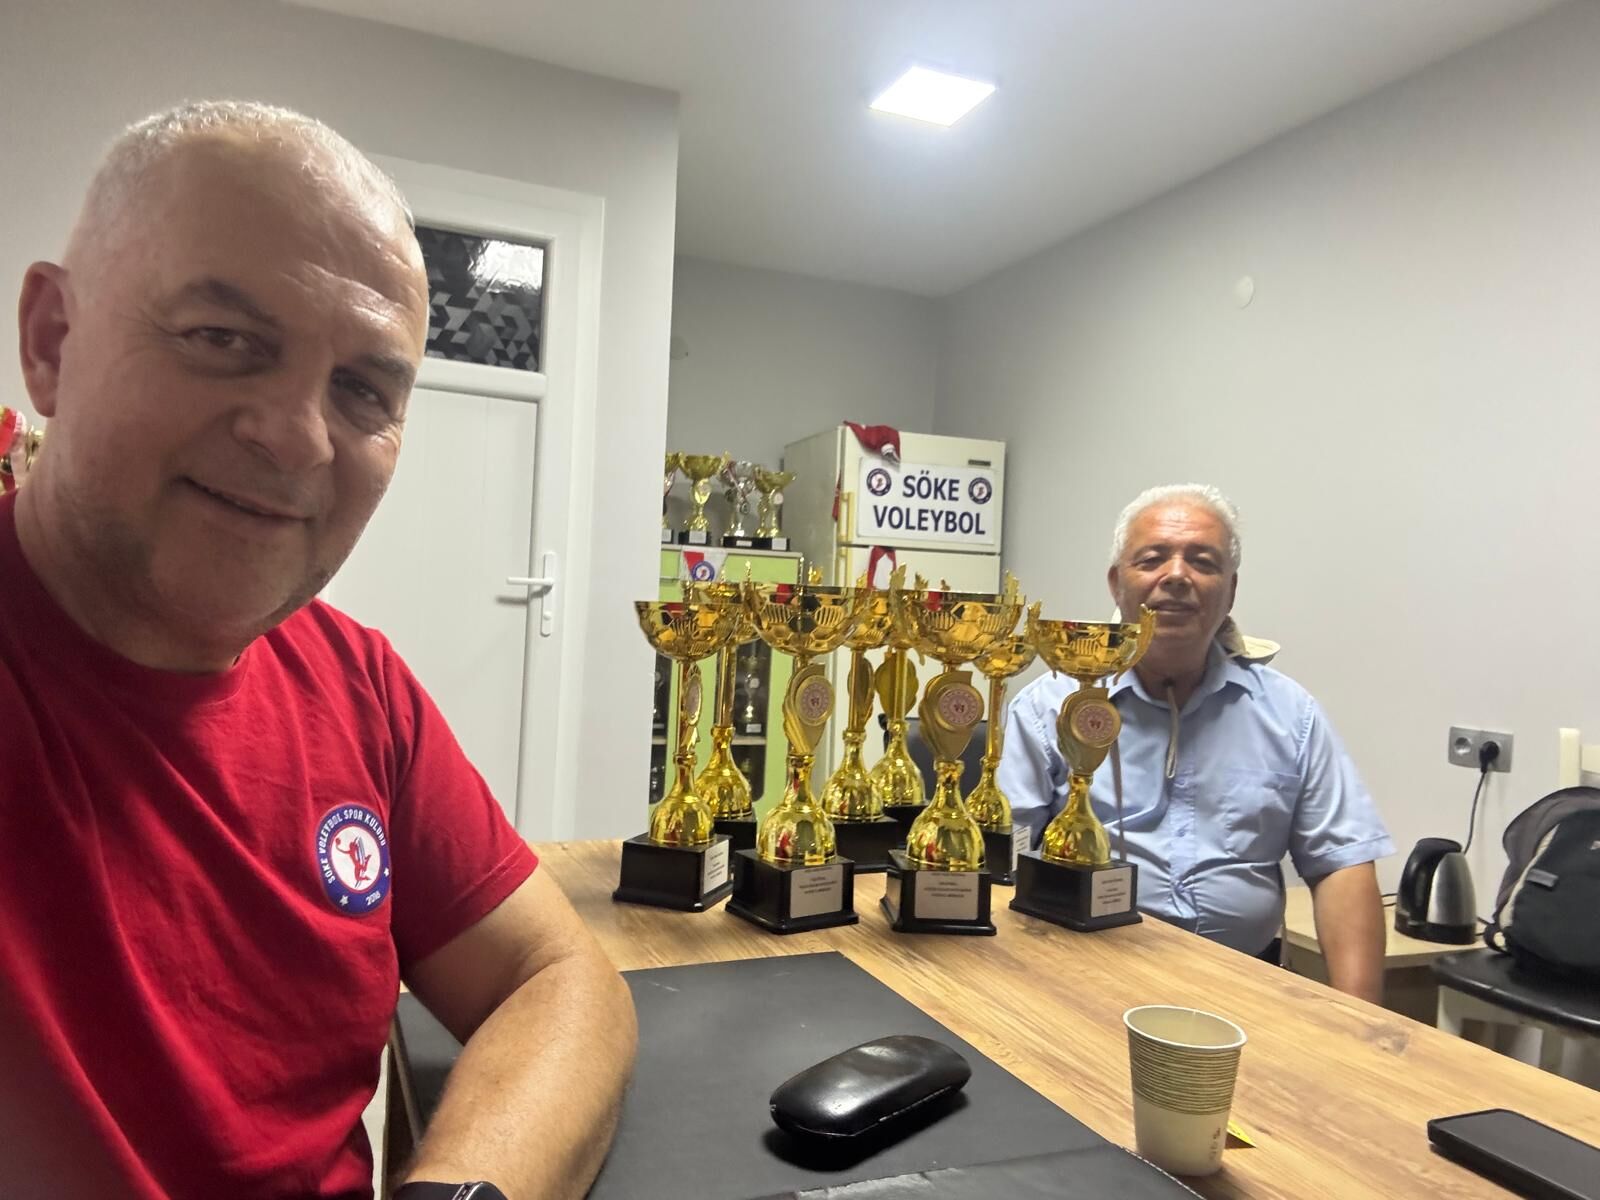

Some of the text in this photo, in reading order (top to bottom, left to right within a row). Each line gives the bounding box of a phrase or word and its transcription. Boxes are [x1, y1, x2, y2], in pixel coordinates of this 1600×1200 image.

[902, 470, 960, 502] SÖKE
[873, 505, 986, 535] VOLEYBOL
[319, 813, 343, 854] VOLEYBOL
[343, 809, 364, 821] SPOR
